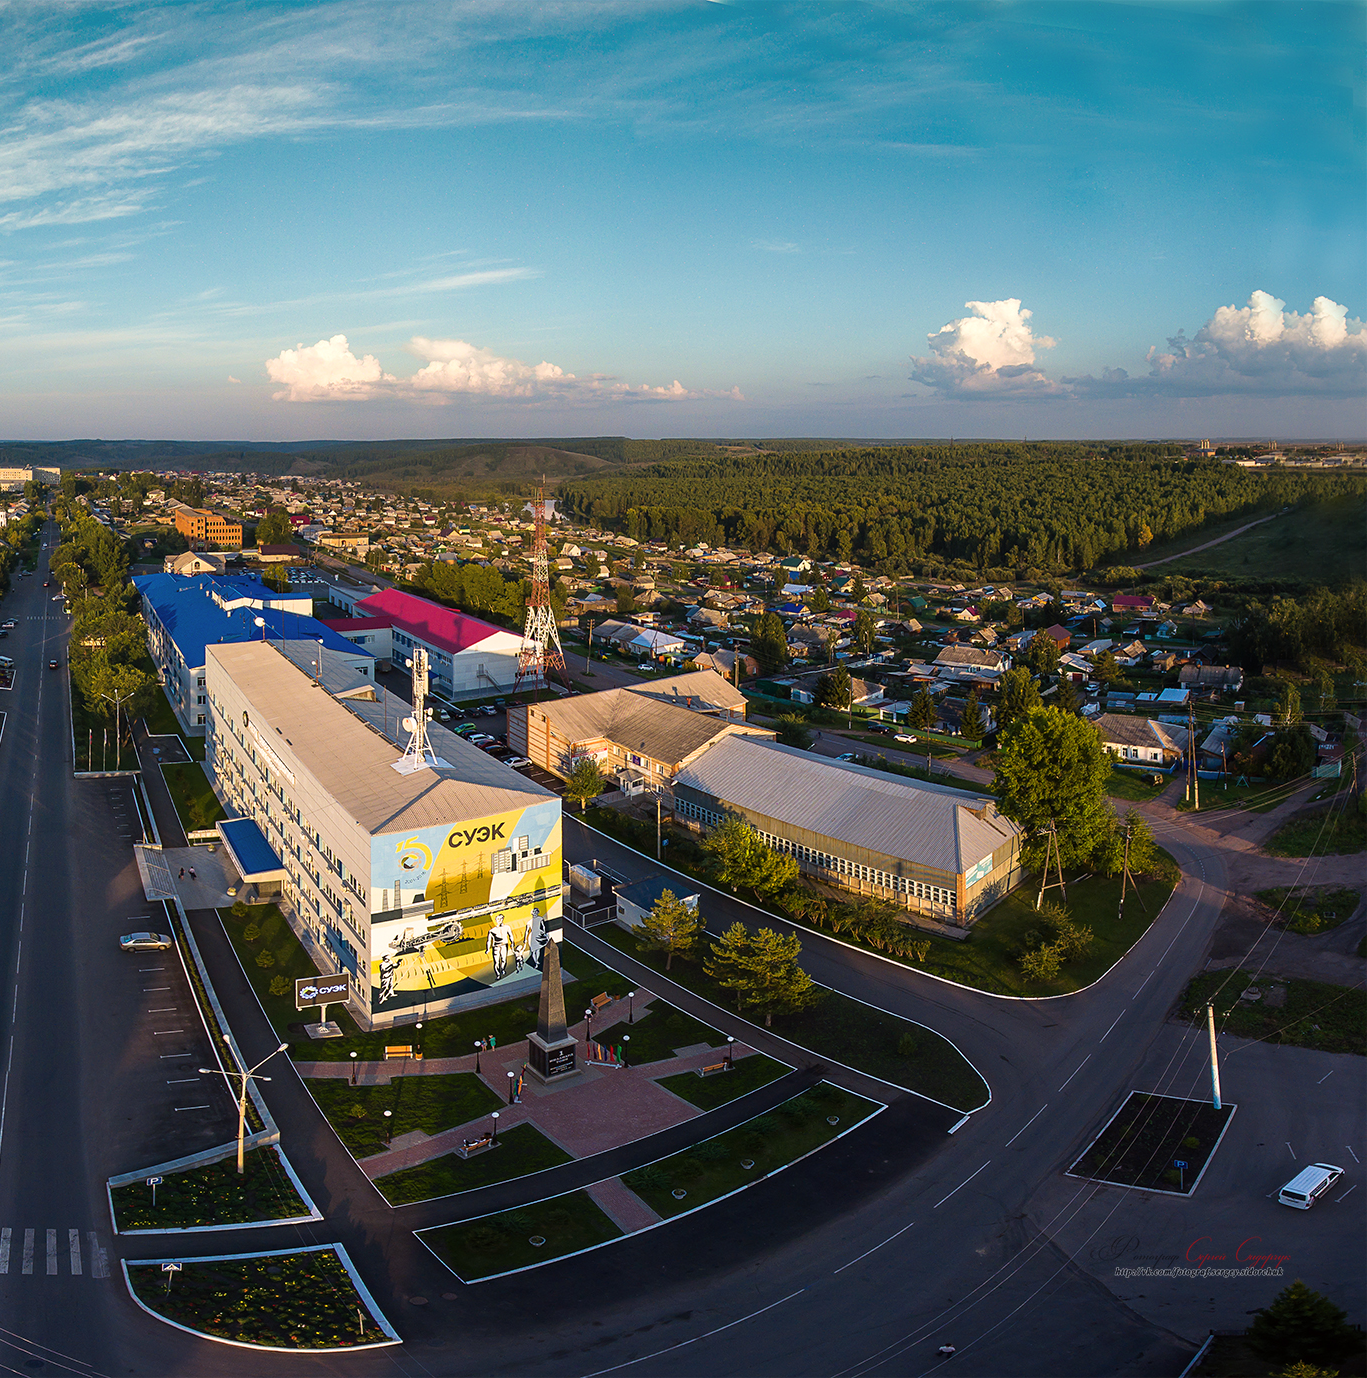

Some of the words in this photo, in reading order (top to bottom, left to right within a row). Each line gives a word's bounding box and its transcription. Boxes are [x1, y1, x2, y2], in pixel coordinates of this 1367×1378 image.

[449, 822, 505, 848] СУЭК
[395, 835, 433, 871] 15
[319, 984, 347, 994] СУЭК
[150, 1177, 159, 1185] P
